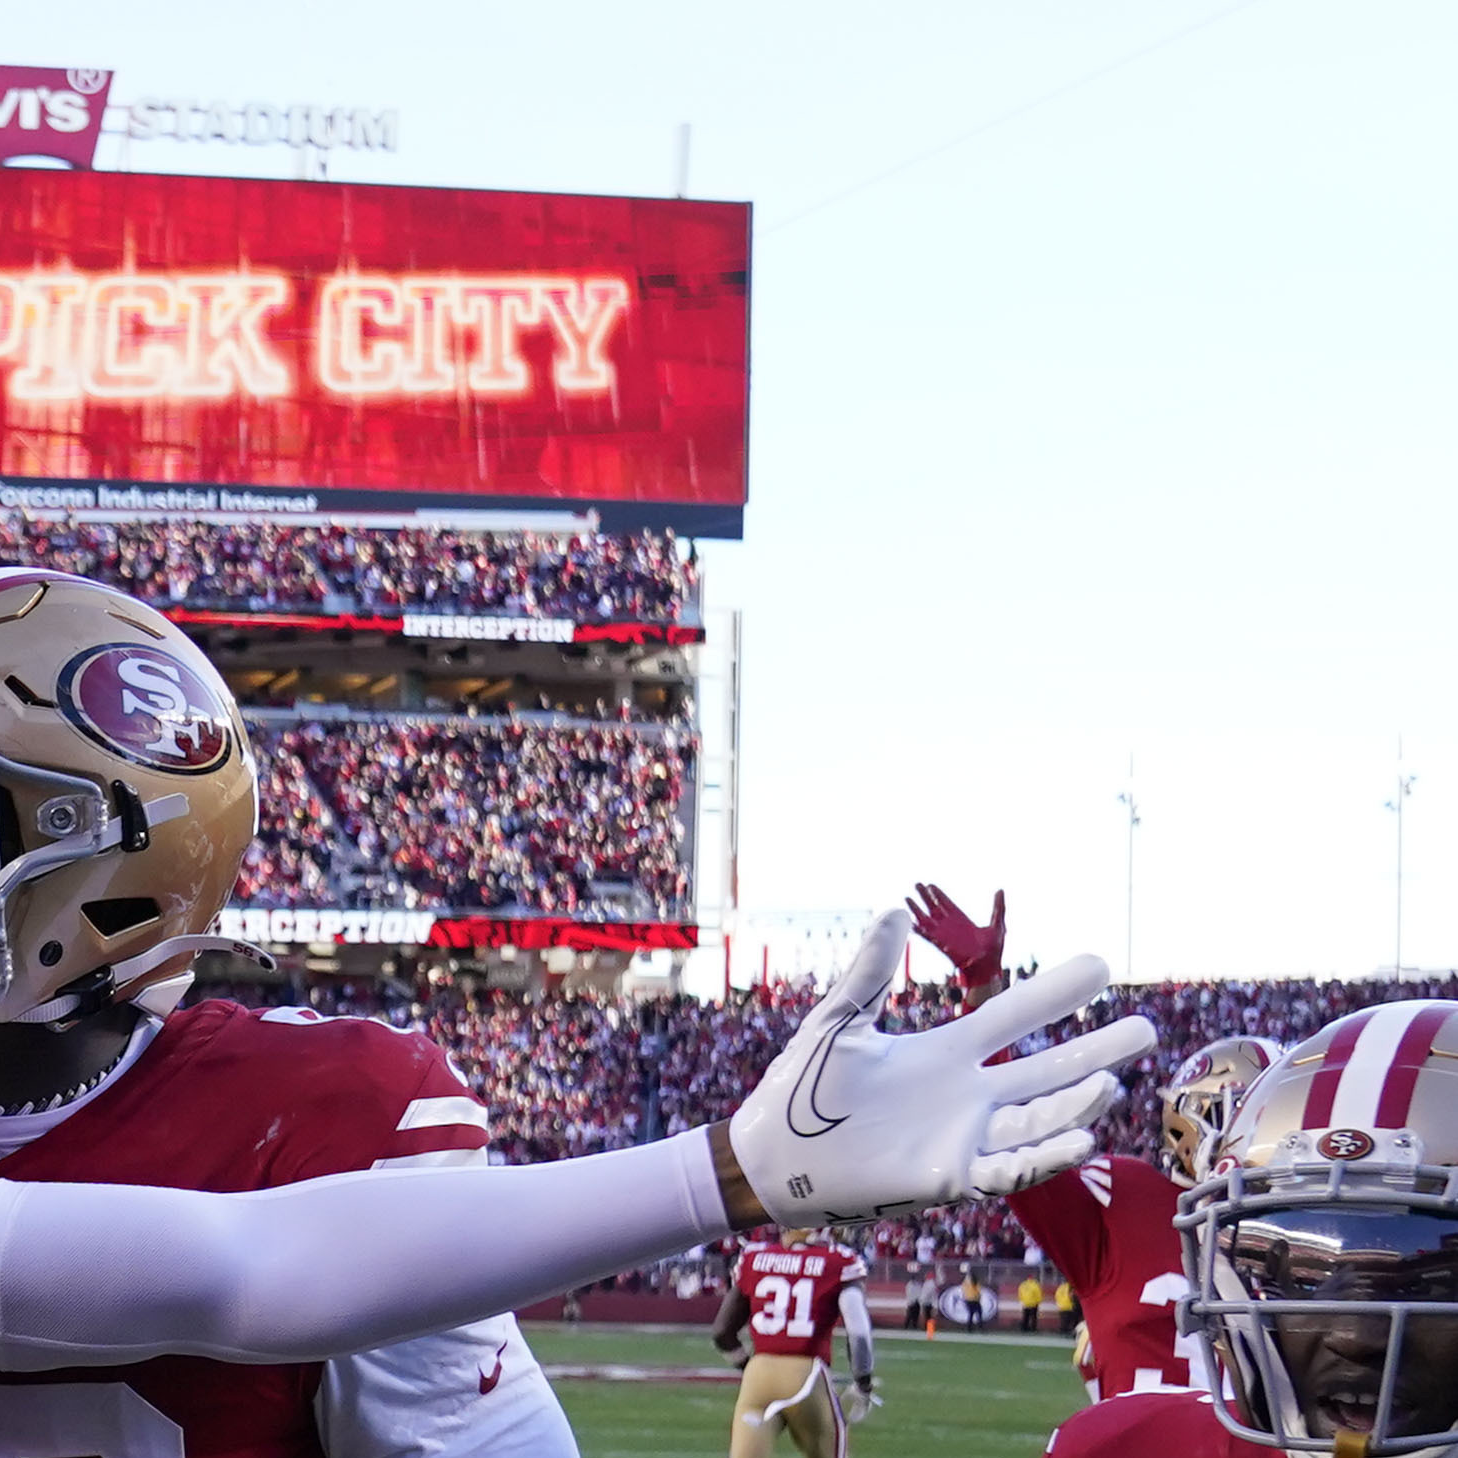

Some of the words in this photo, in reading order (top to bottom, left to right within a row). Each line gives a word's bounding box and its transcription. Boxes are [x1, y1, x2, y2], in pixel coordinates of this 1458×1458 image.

[129, 97, 399, 151] STADIUM
[317, 273, 628, 393] CITY
[98, 484, 217, 511] Industrial
[220, 490, 319, 513] Internet
[402, 613, 575, 643] INTERCEPTION
[217, 908, 436, 944] ERCEPTION
[752, 1252, 803, 1275] GIPSON
[751, 1275, 815, 1338] 31
